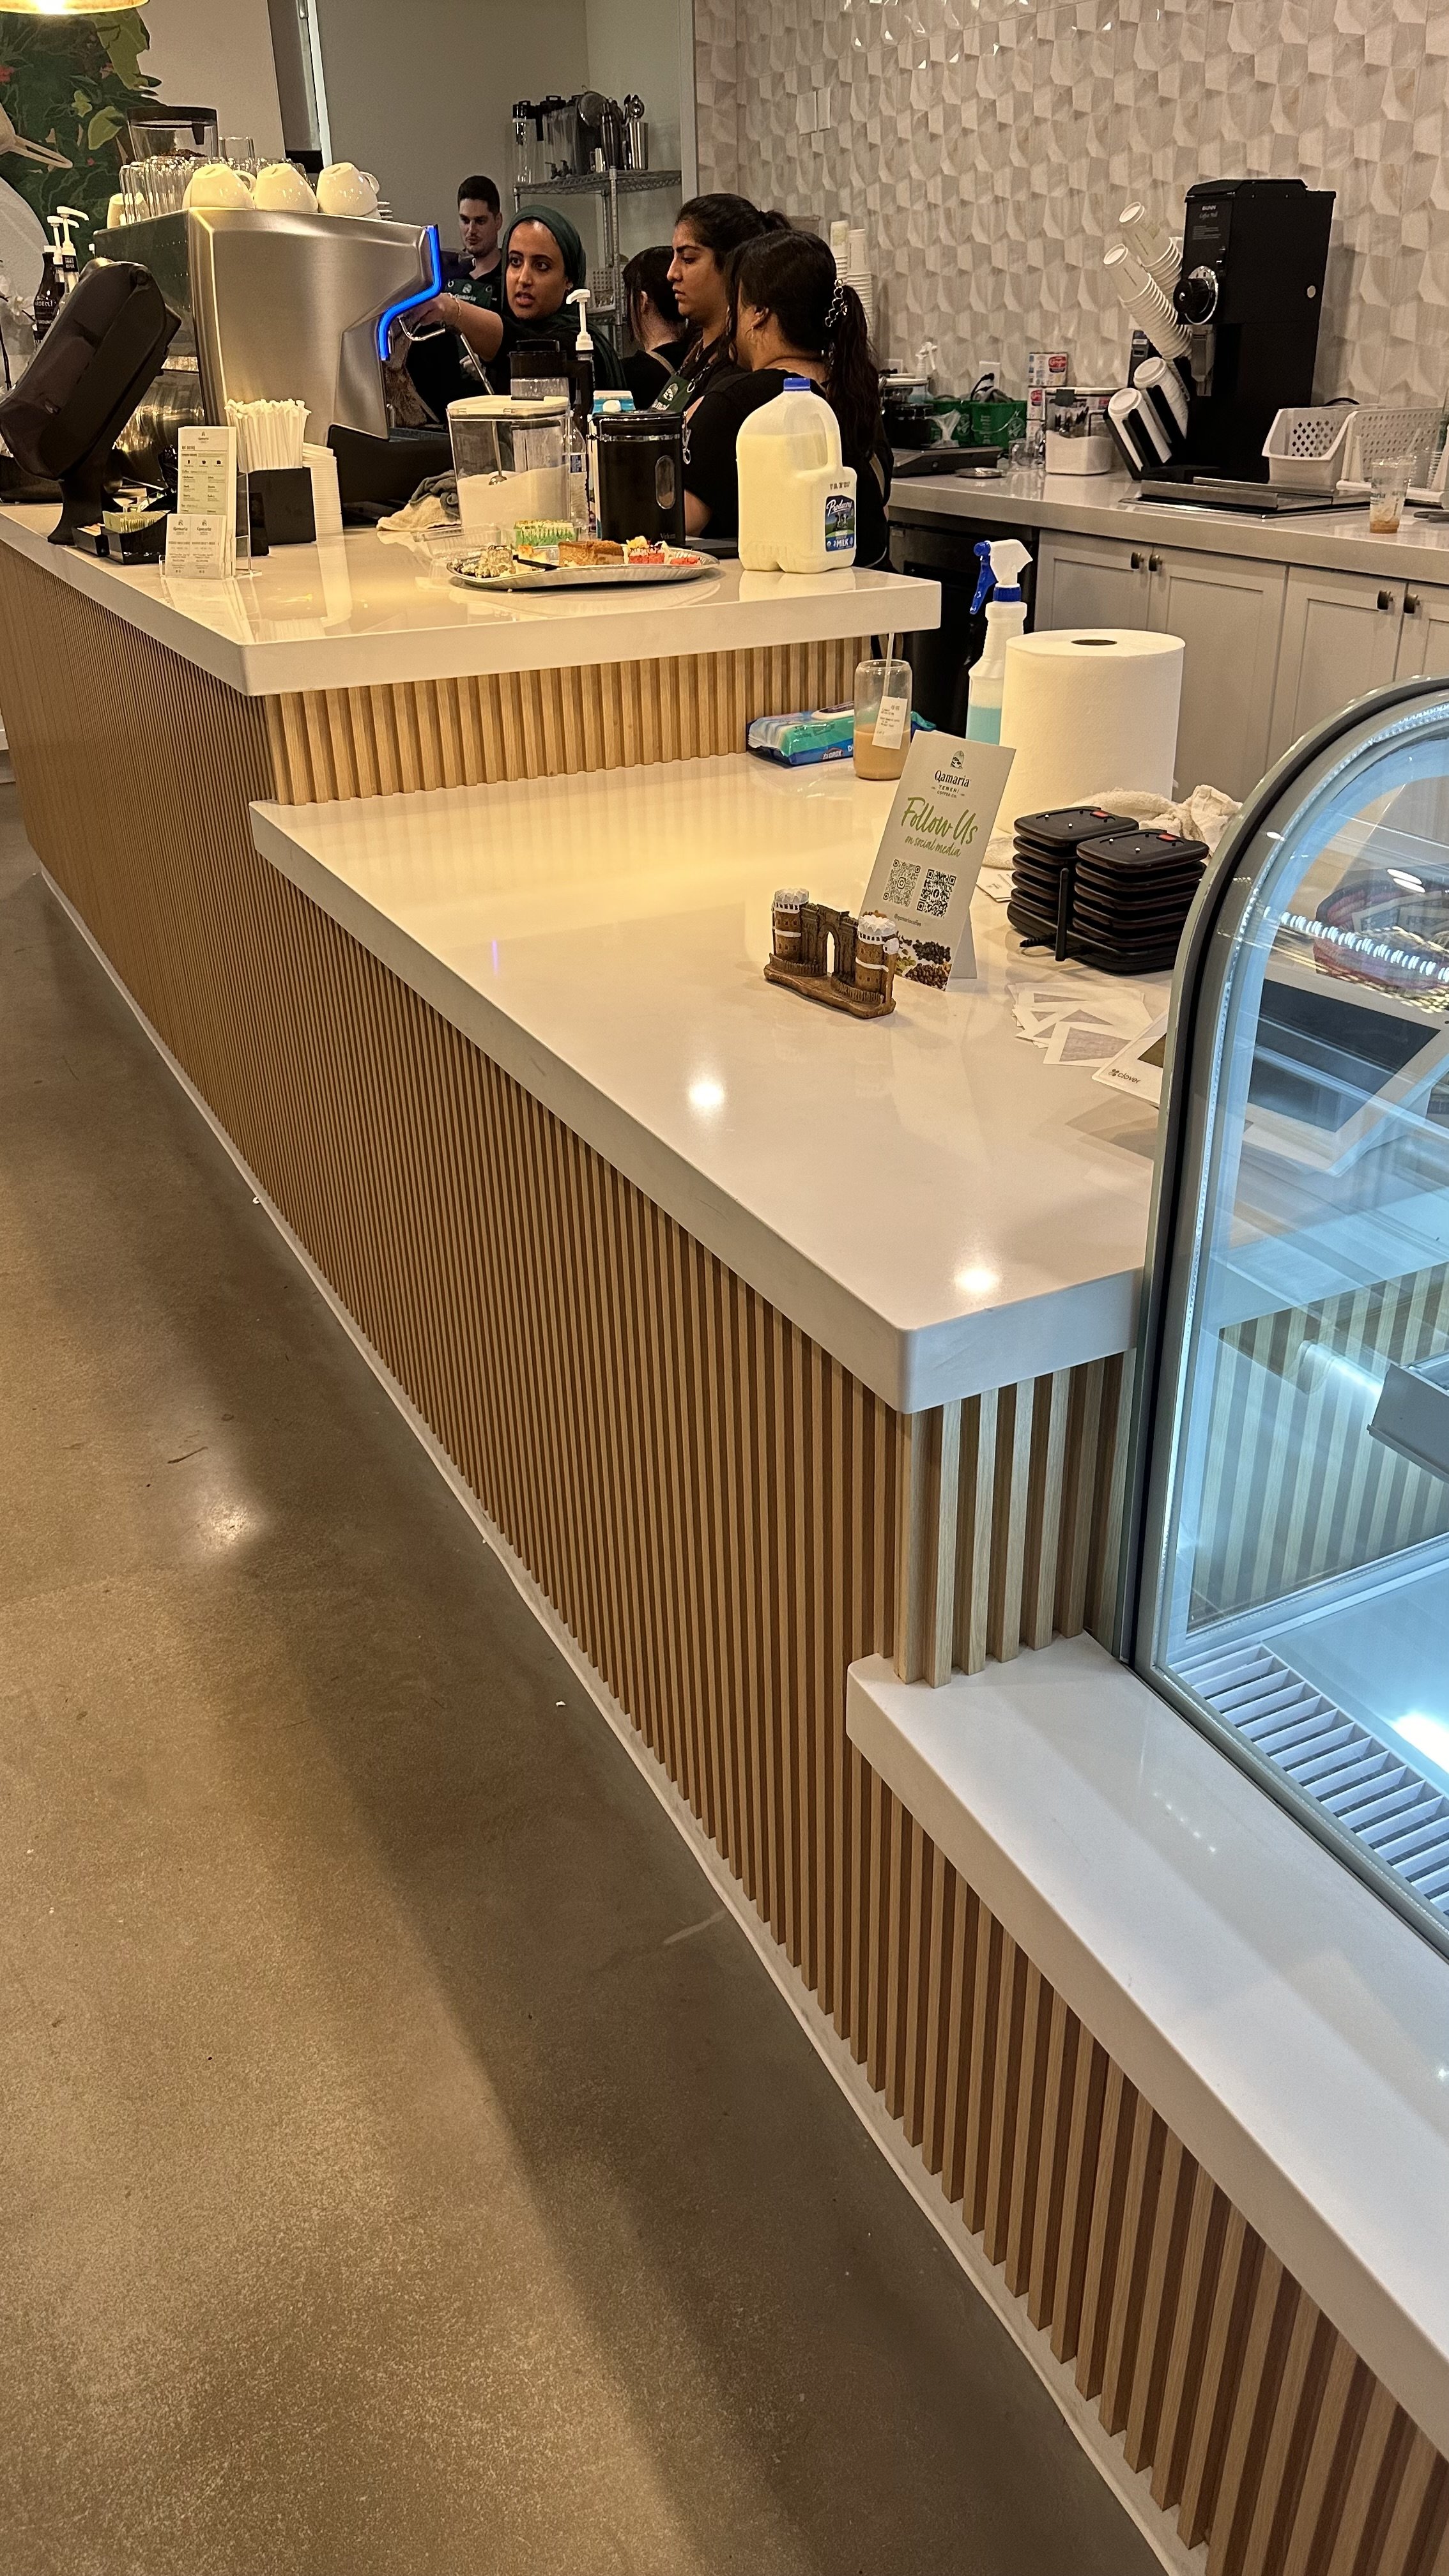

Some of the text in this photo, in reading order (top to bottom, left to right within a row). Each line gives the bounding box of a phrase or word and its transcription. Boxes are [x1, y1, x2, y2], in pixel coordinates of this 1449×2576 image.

[836, 538, 849, 548] MILK
[935, 770, 970, 787] Qamaria
[939, 784, 960, 793] YEMENI
[901, 797, 978, 845] Follow Us
[905, 835, 962, 857] on social media
[1117, 1072, 1141, 1084] clover
